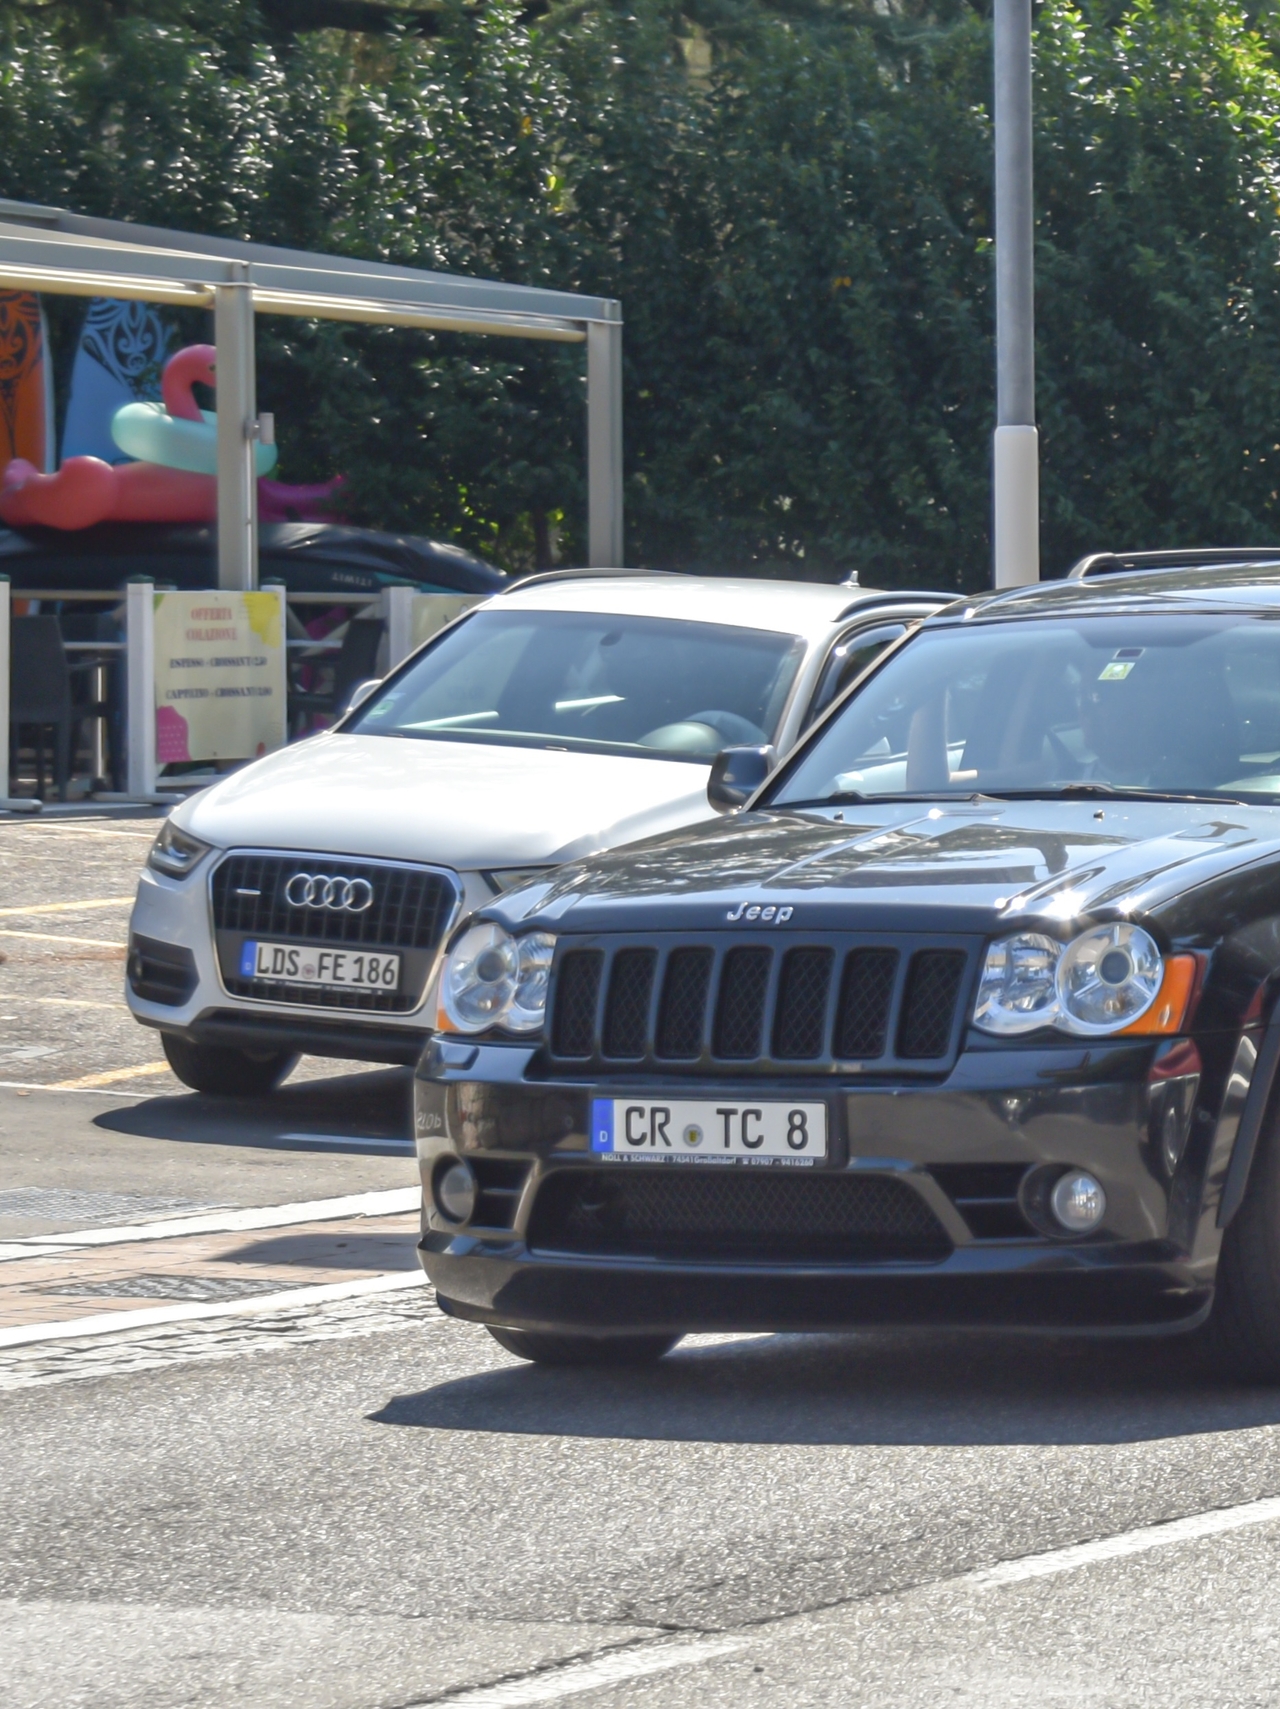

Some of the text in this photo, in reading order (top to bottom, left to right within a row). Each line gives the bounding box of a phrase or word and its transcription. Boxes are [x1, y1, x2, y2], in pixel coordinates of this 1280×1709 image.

[726, 901, 794, 925] Jeep
[257, 946, 395, 986] LDS FE 186
[600, 1131, 608, 1143] D
[625, 1106, 809, 1150] CR TC 8
[601, 1153, 621, 1162] NOLL
[630, 1154, 666, 1163] SCHWARZ
